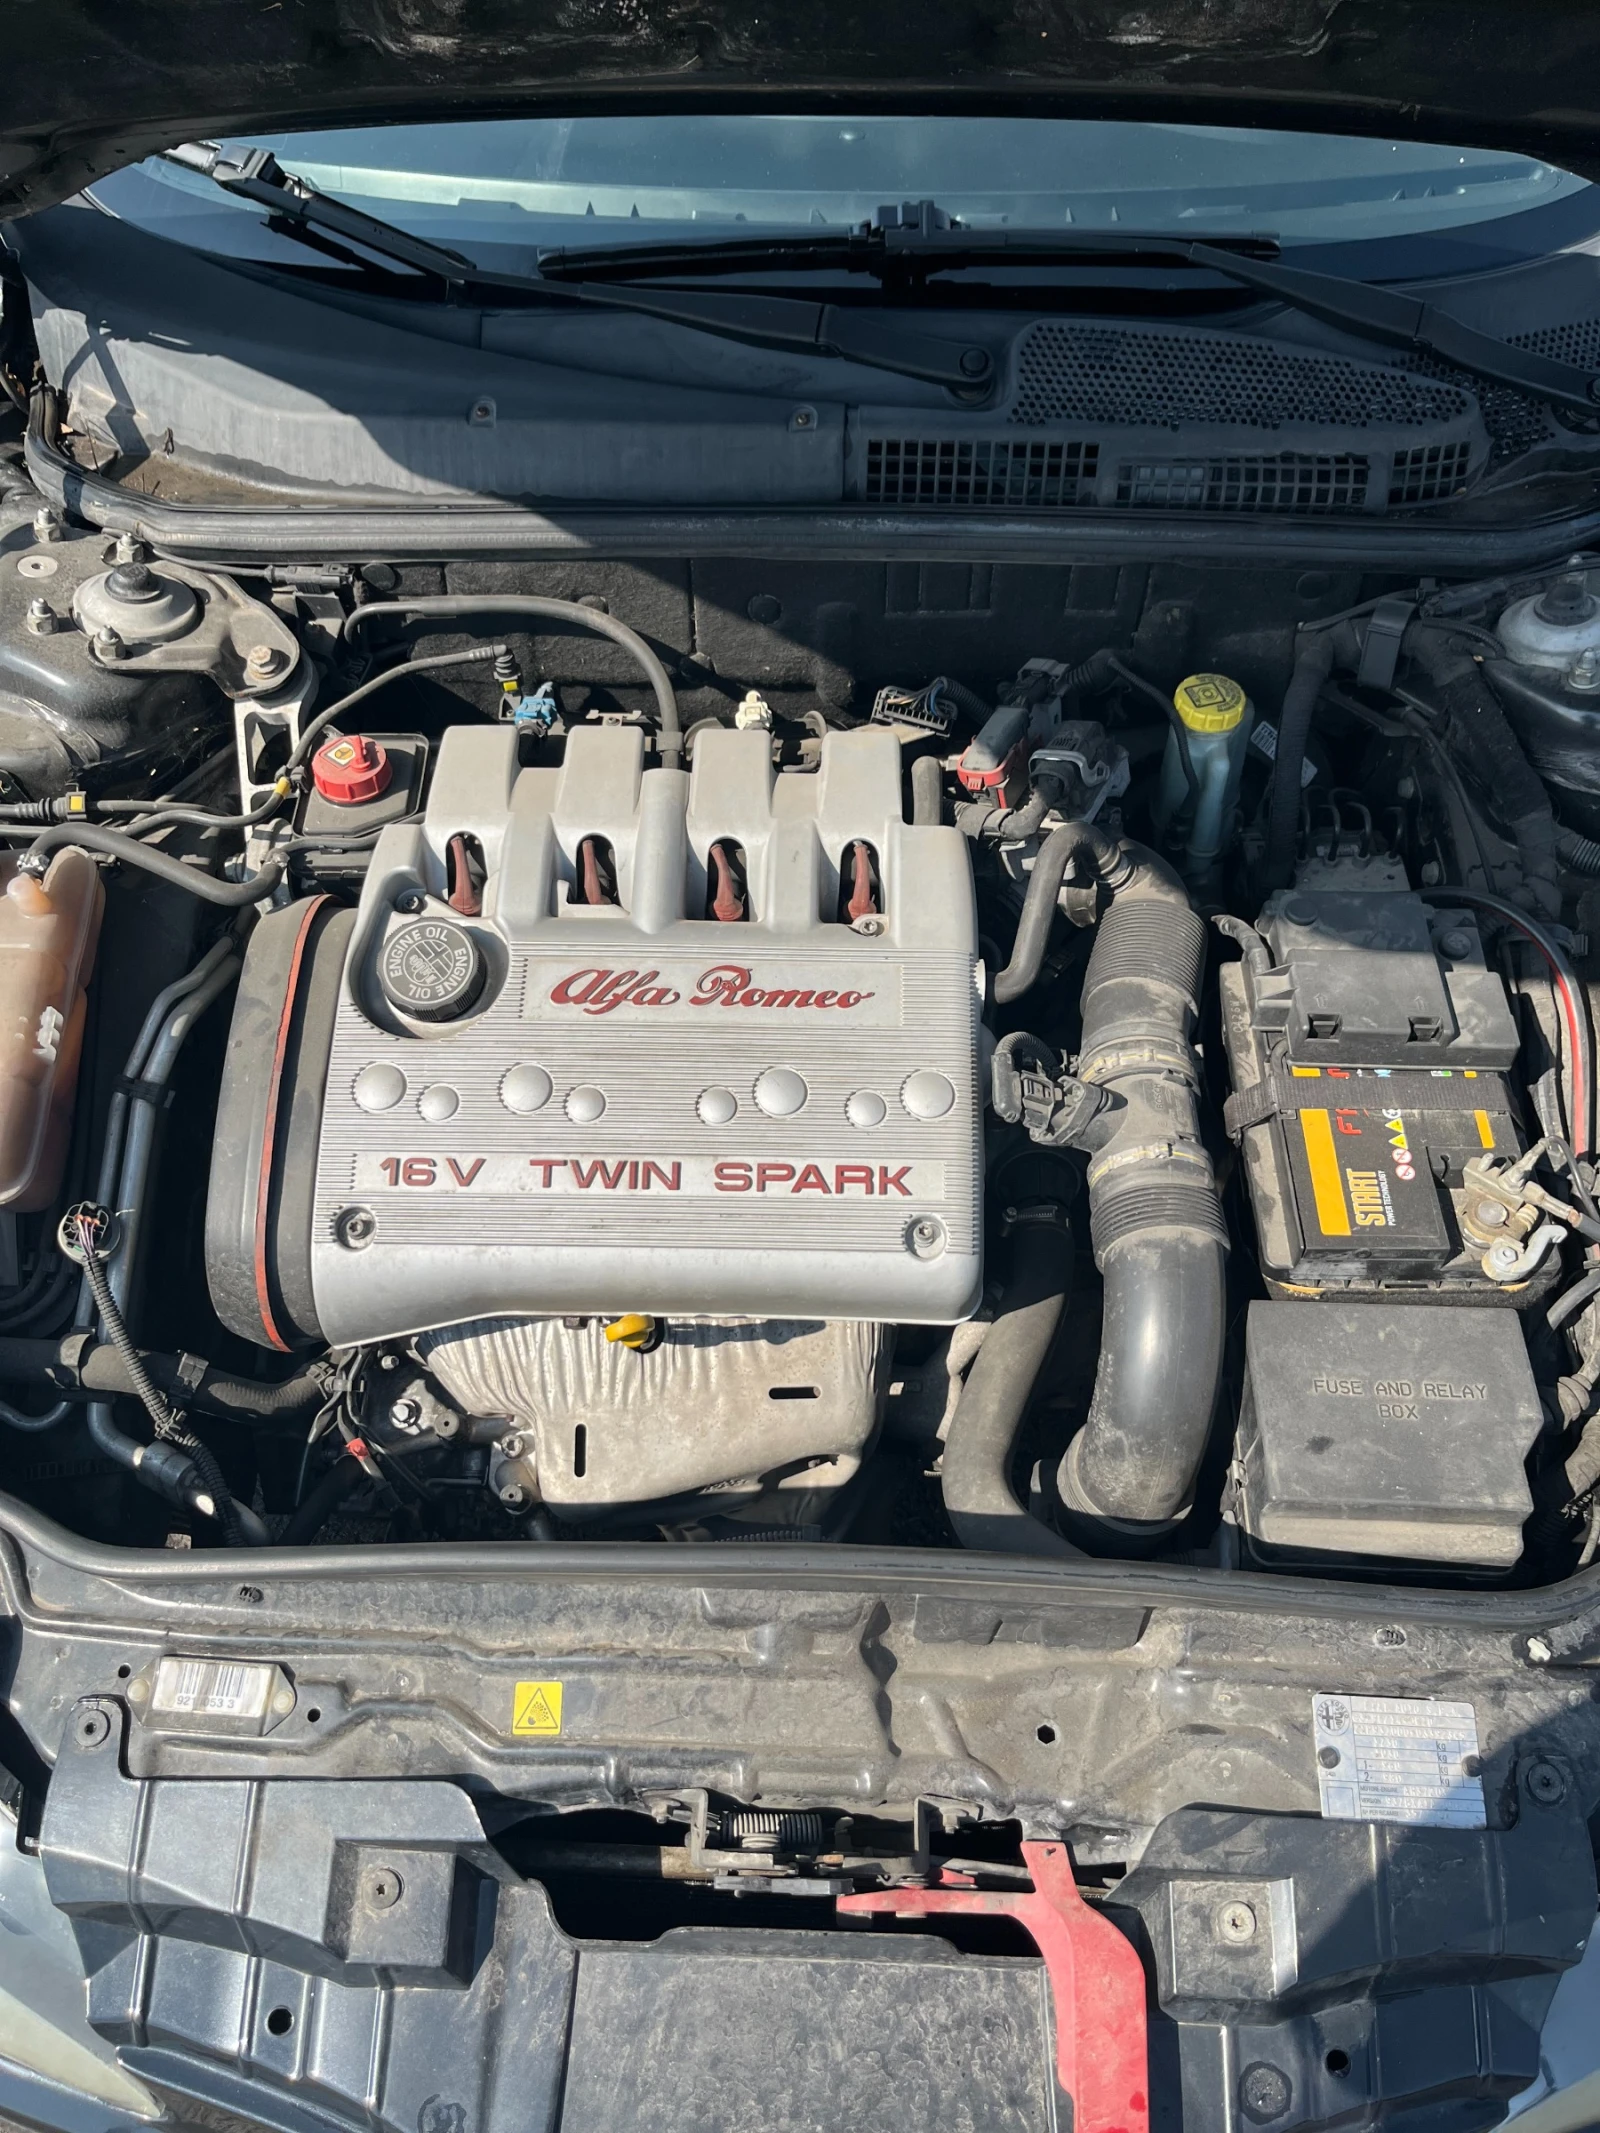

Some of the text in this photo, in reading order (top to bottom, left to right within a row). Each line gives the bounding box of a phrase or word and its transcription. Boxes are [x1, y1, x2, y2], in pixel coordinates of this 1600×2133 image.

[388, 926, 448, 978] ENGINE OIL
[408, 947, 468, 999] ENGINE OIL
[550, 964, 876, 1015] Alfa Romeo
[529, 1158, 682, 1191] TWIN
[713, 1161, 914, 1196] SPARK
[1345, 1167, 1387, 1227] START
[1377, 1170, 1397, 1227] POWER TECHNOLOGY
[1313, 1379, 1487, 1399] FUSE AND RELAY
[1378, 1403, 1419, 1420] BOX
[1436, 1741, 1446, 1751] kg
[1437, 1753, 1448, 1763] kg
[1439, 1765, 1449, 1775] kg
[1440, 1776, 1450, 1787] kg
